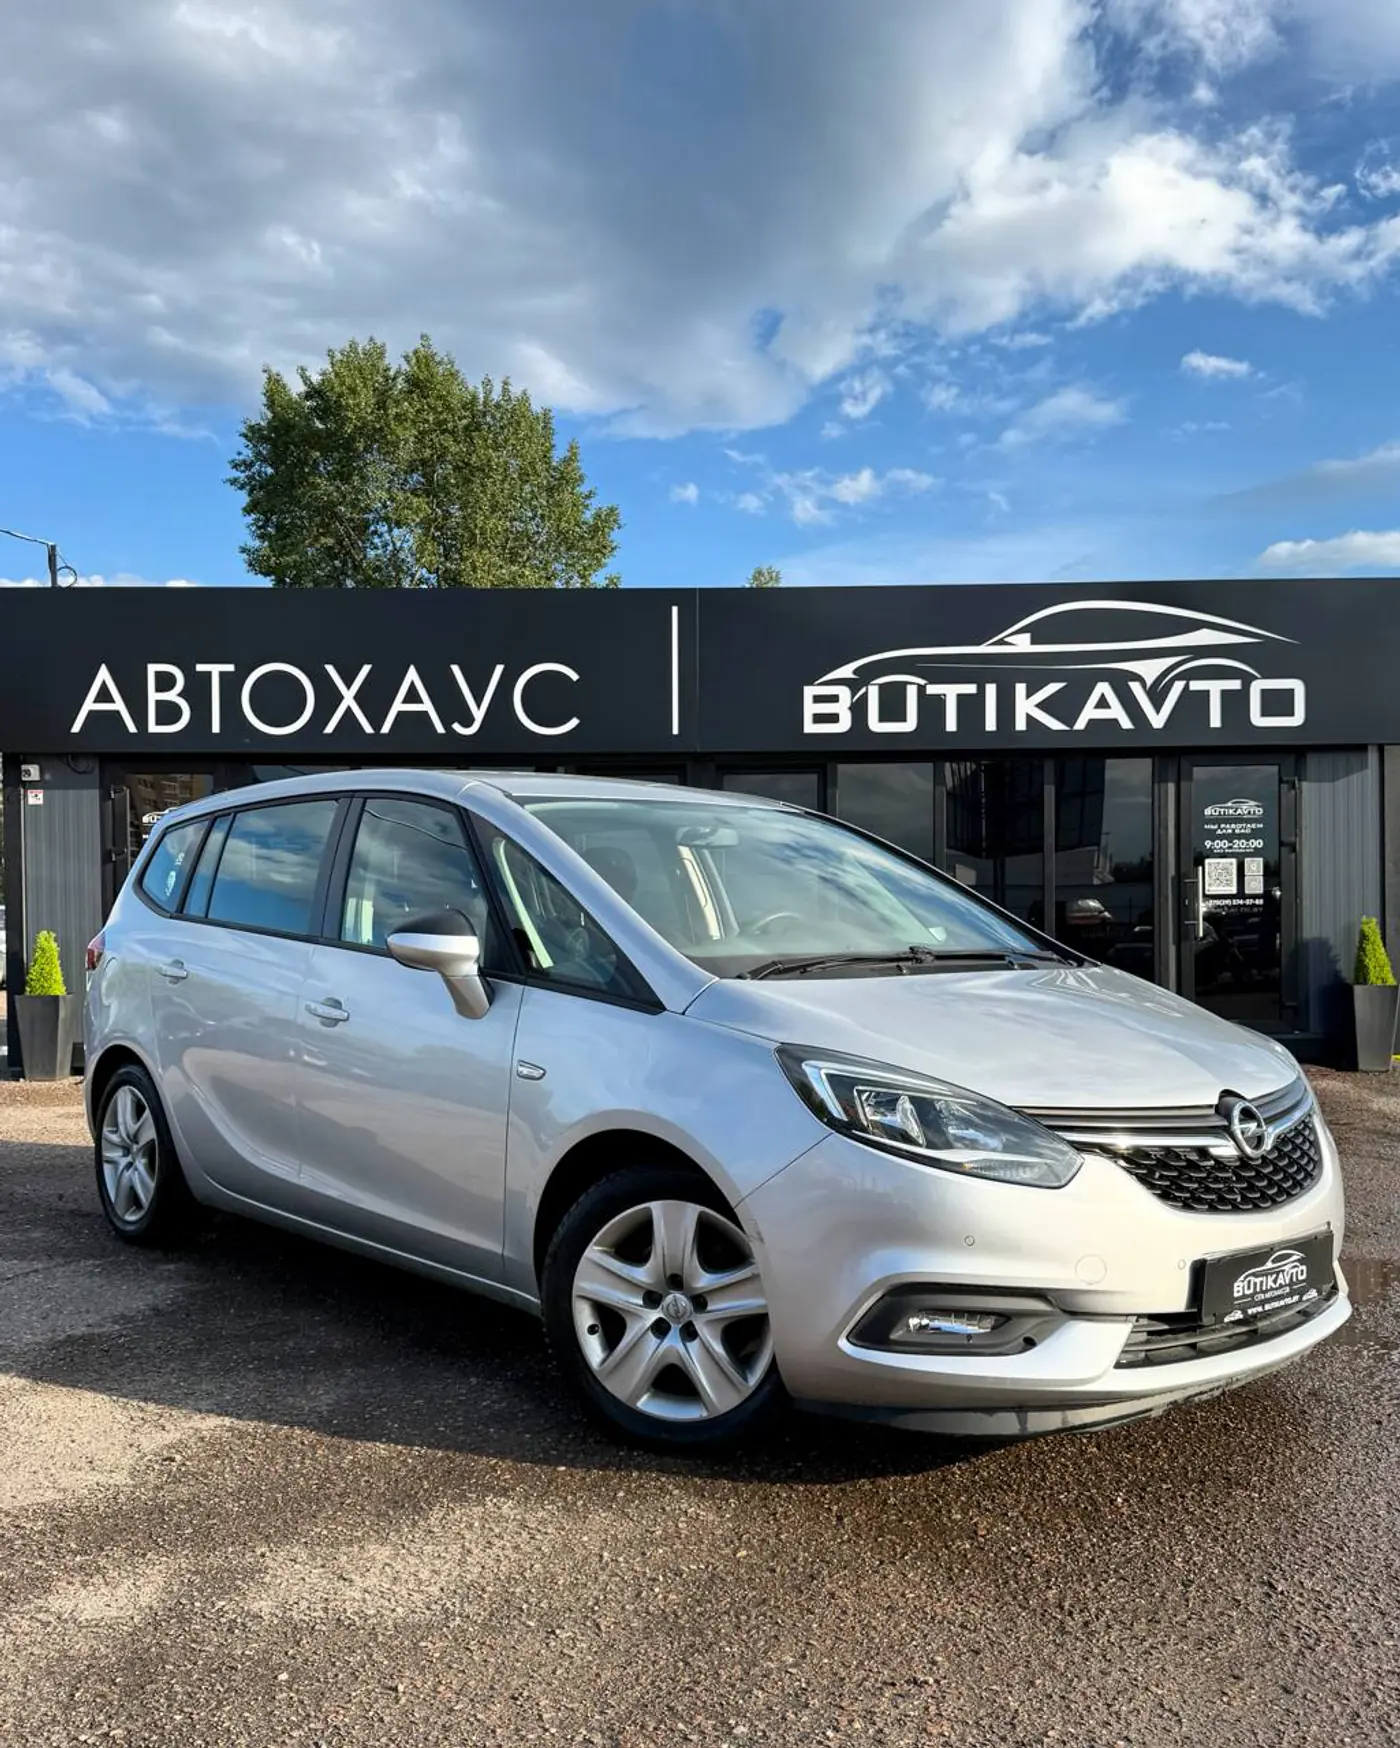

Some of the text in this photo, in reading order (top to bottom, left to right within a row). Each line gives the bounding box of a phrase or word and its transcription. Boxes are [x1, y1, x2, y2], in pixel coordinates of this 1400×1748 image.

[71, 662, 580, 735] АВТОХАУС
[803, 678, 1305, 734] BUTIKAVTO
[1204, 808, 1263, 816] BUTIKAVTO
[1204, 839, 1263, 849] 9:00-20:00
[1233, 1265, 1307, 1298] BUTIKAVTO
